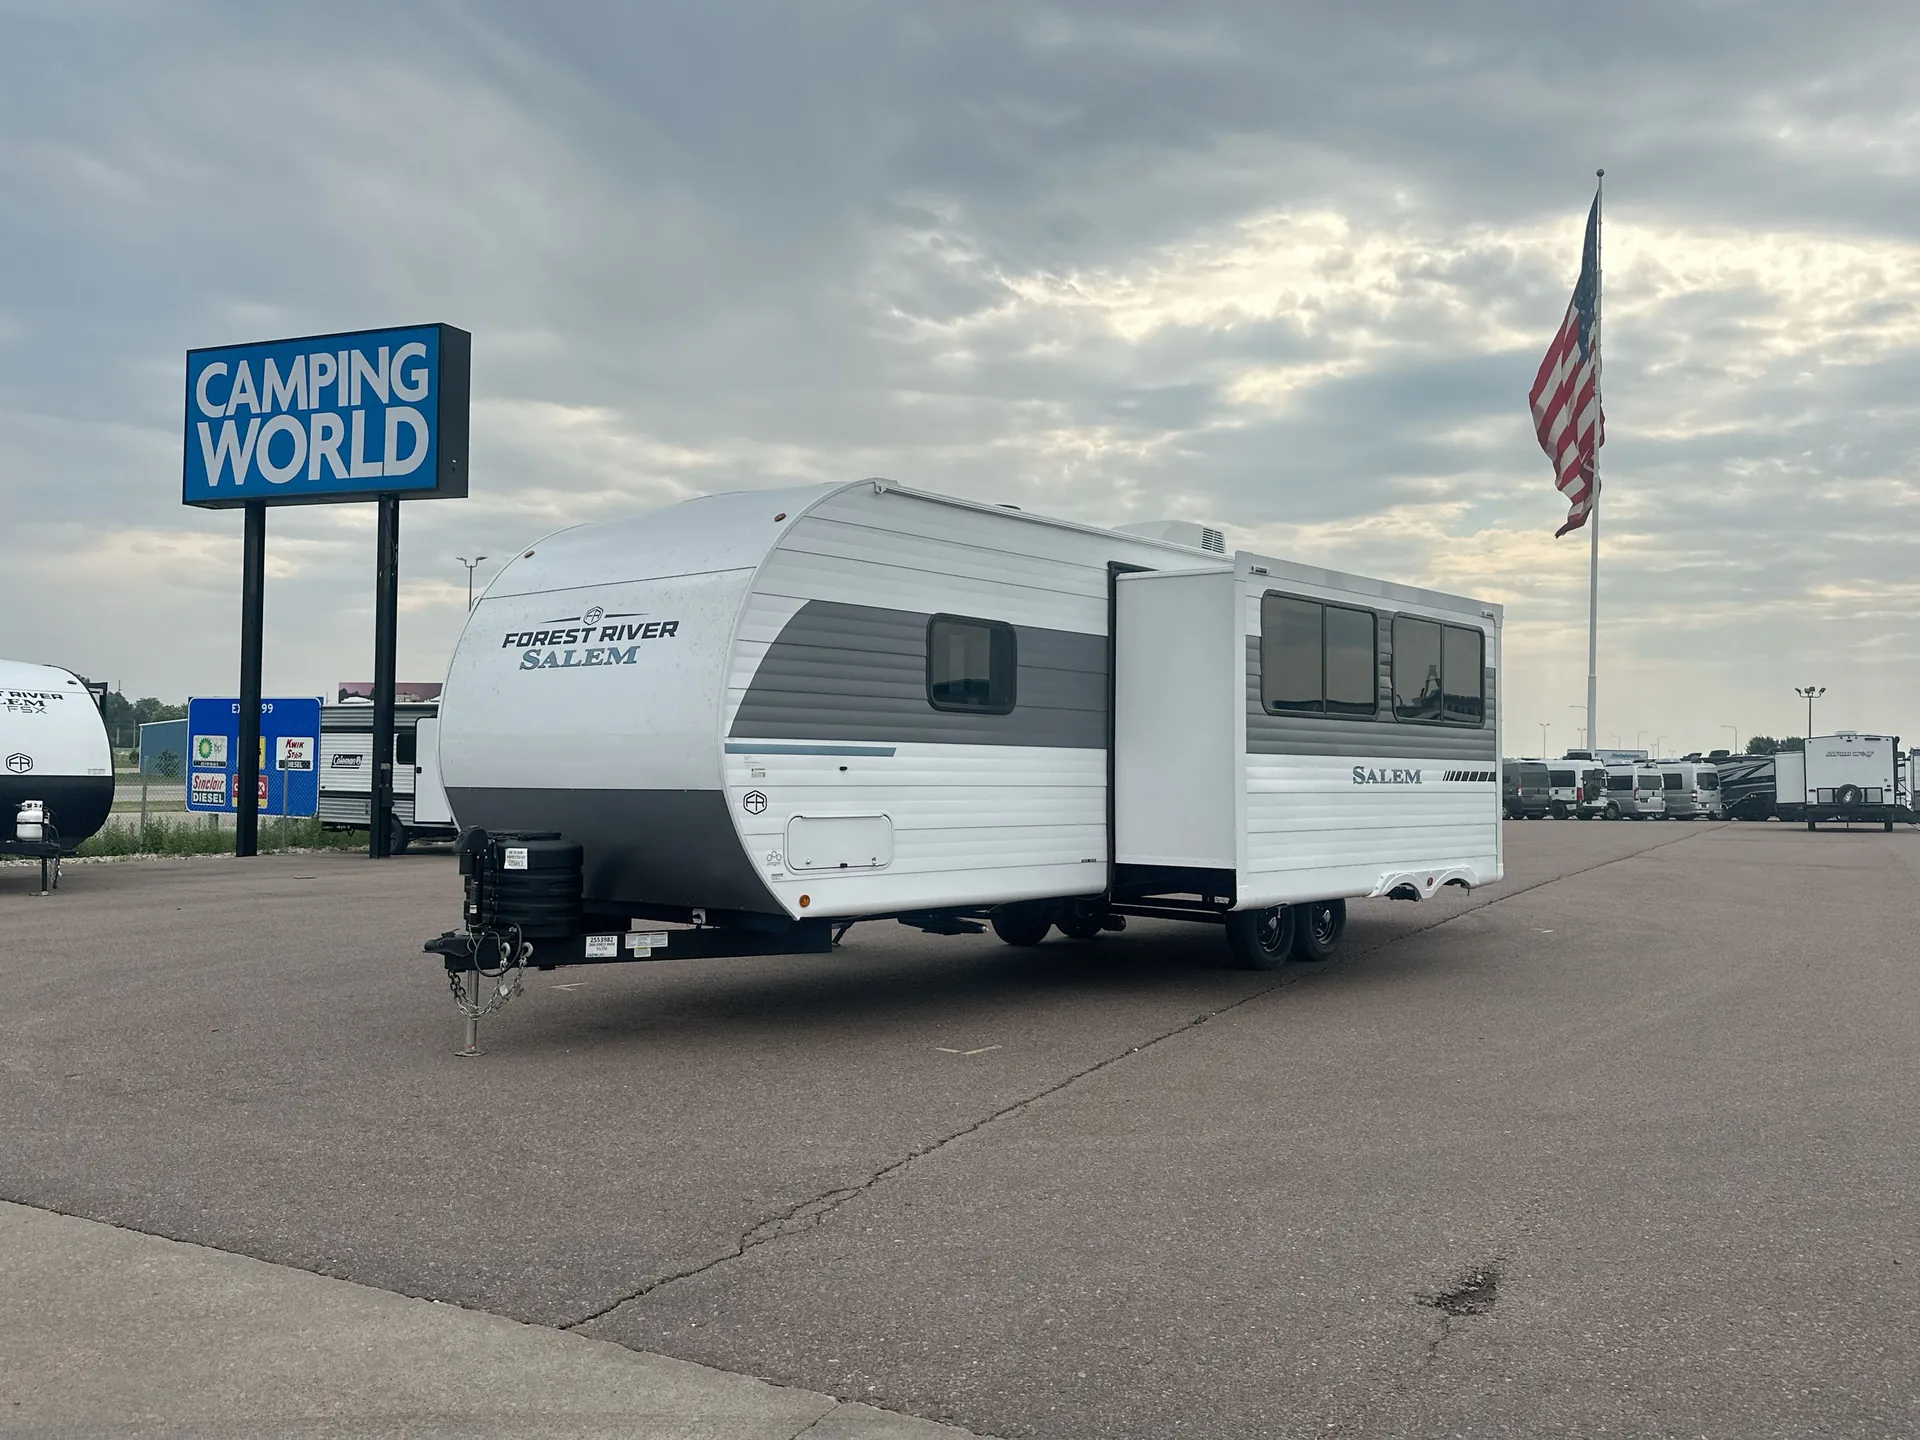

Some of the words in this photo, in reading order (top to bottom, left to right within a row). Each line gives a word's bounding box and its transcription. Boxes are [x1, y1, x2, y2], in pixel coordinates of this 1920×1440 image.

[196, 342, 429, 418] CAMPING
[196, 406, 429, 487] WORLD
[502, 627, 597, 648] FOREST
[599, 620, 680, 643] RIVER
[519, 645, 641, 670] SALEM
[8, 691, 64, 700] RIVER
[7, 705, 48, 714] FSX
[193, 775, 224, 790] Sinclair
[1352, 765, 1422, 784] SALEM
[193, 792, 224, 803] DIESEL
